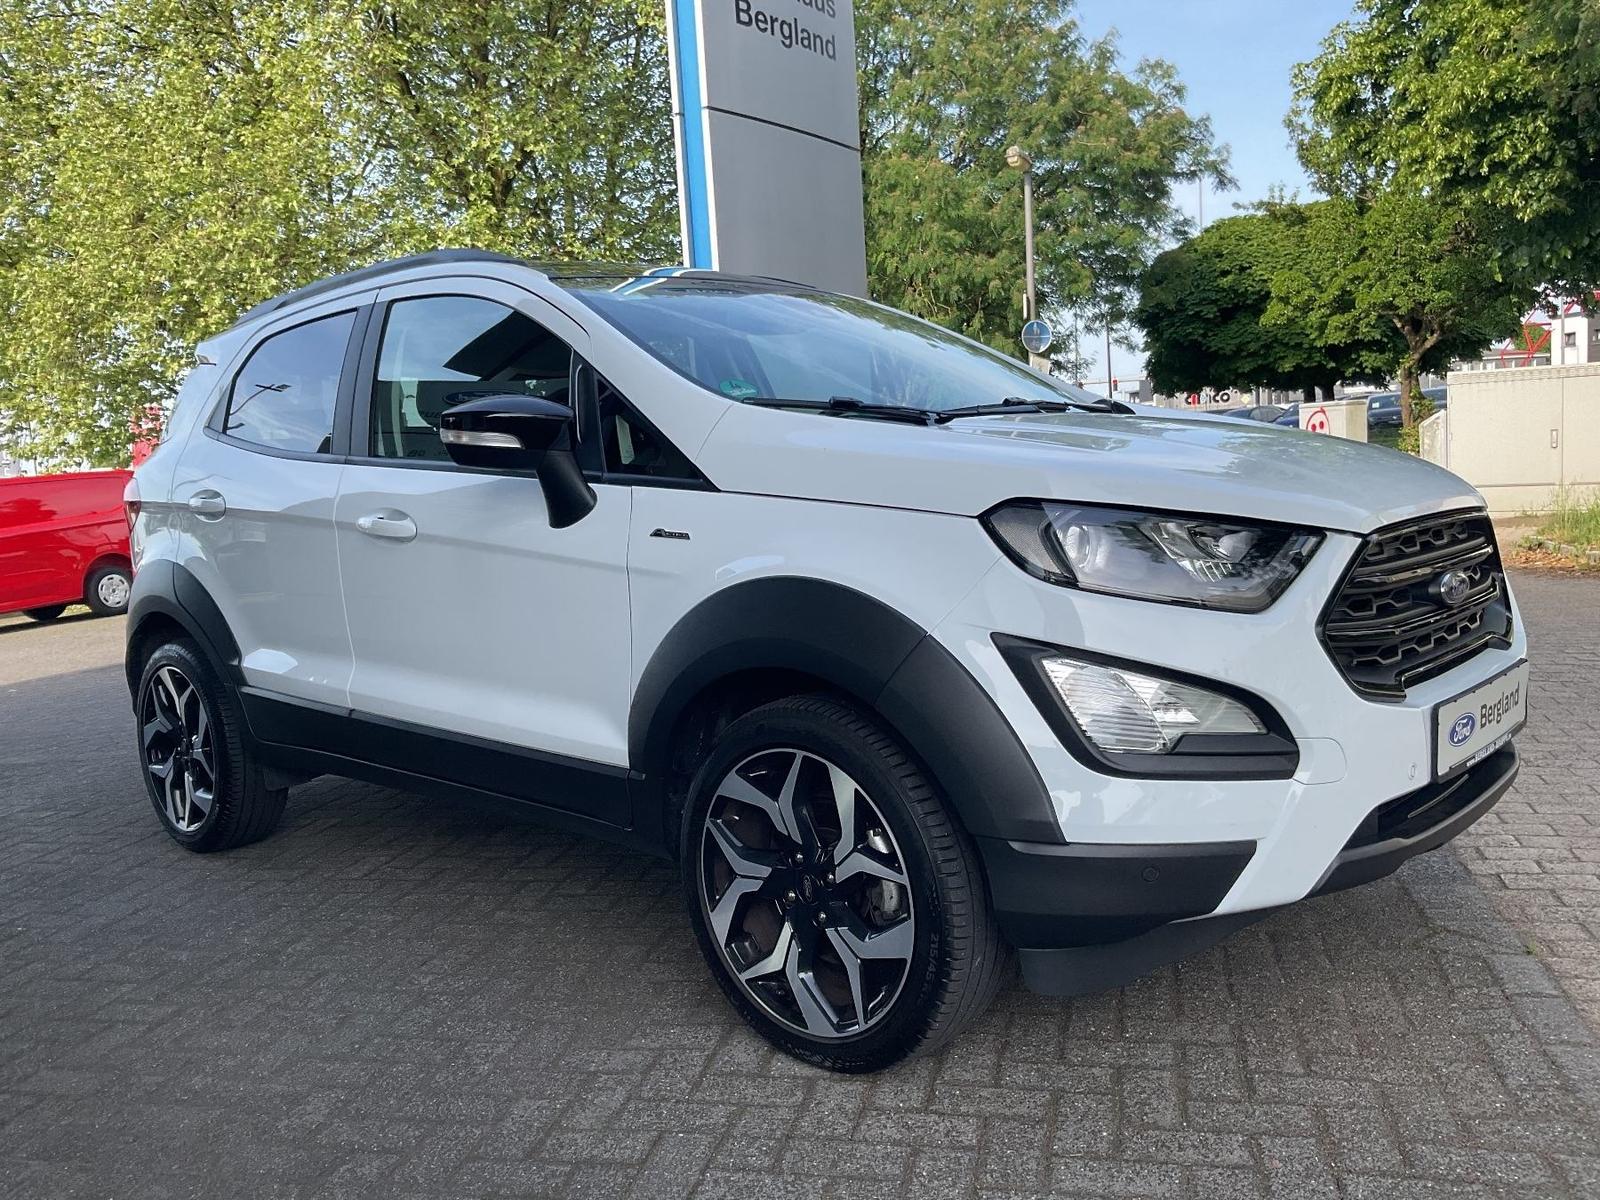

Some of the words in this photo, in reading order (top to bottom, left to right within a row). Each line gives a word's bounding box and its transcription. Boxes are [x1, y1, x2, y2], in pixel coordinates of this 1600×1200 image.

[735, 0, 836, 61] Bergland
[1452, 716, 1473, 743] Ford
[1480, 681, 1520, 729] Bergland
